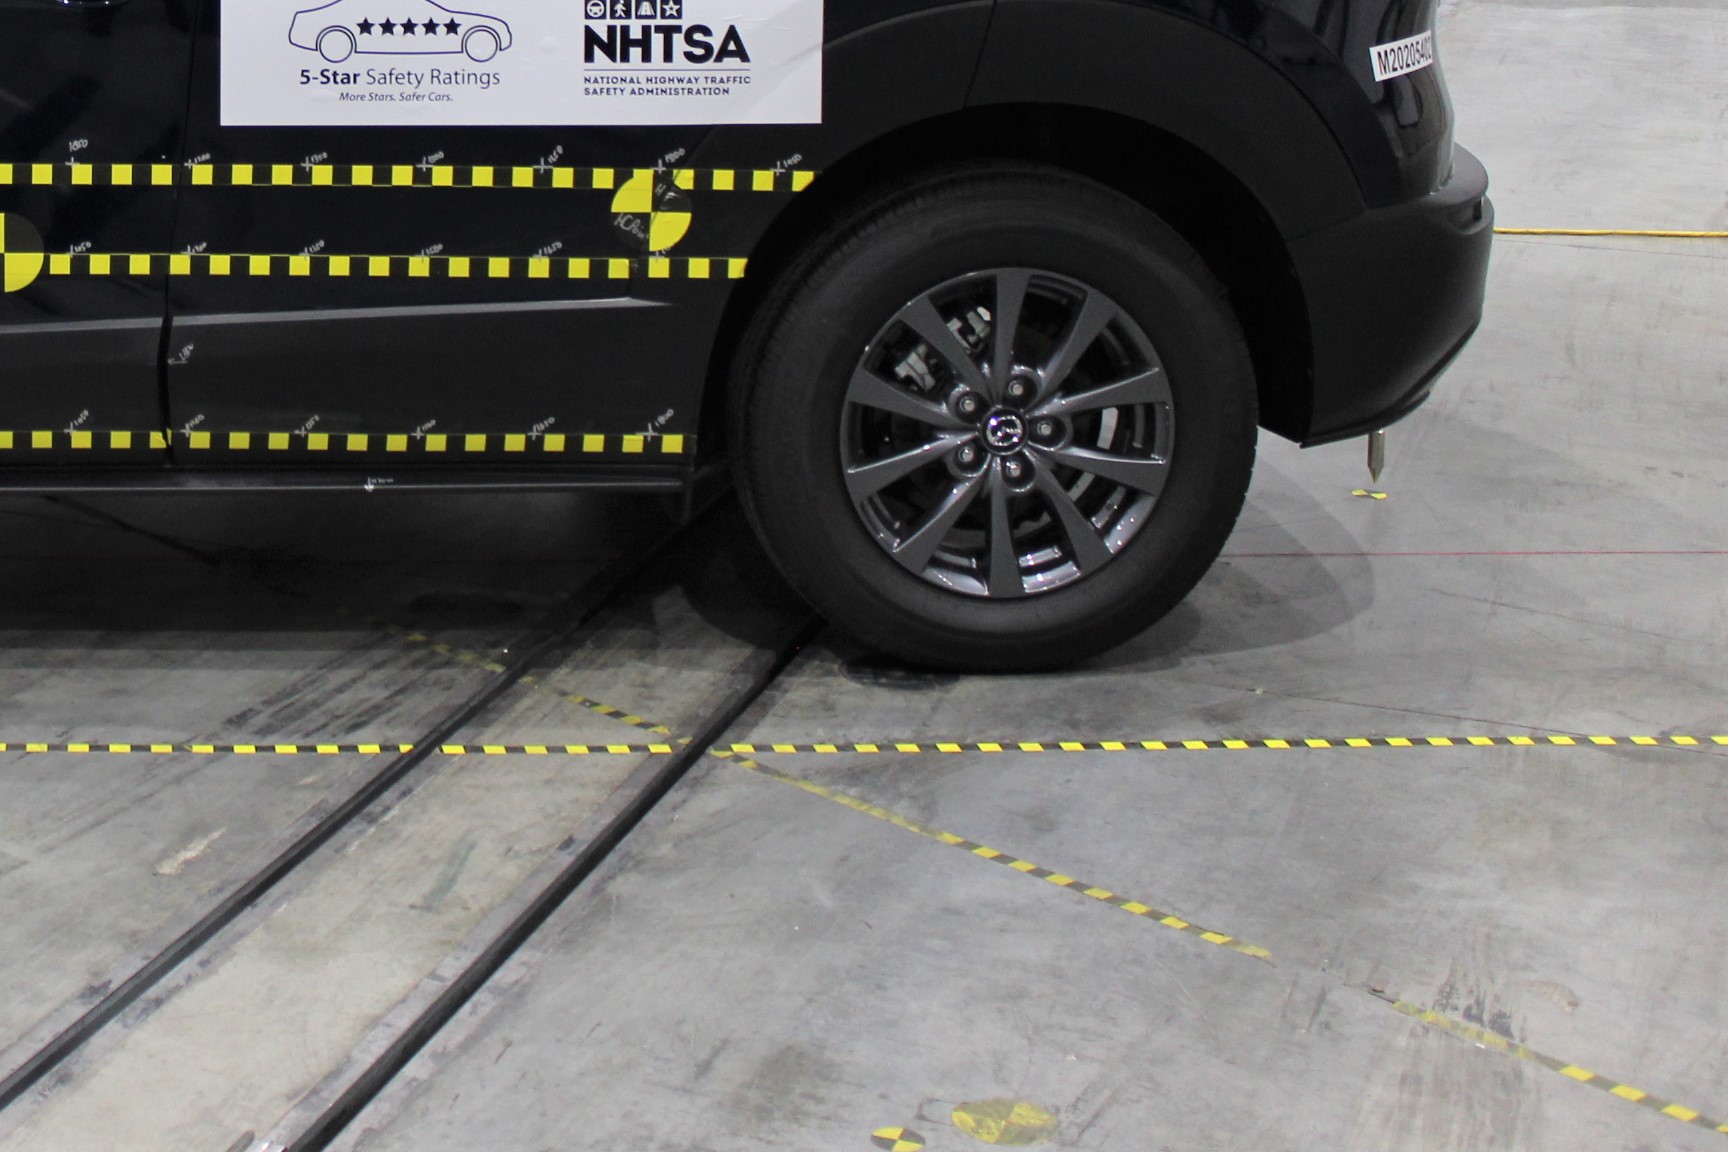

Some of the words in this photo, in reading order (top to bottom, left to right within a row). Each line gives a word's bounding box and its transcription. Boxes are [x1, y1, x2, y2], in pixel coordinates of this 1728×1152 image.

[584, 24, 751, 64] NHTSA
[299, 69, 361, 85] 5-Star
[366, 68, 424, 89] Safety
[430, 68, 500, 90] Ratings
[584, 76, 641, 85] NATIONAL
[646, 76, 700, 85] HIGHWAY
[704, 76, 751, 85] TRAFFIC
[584, 87, 626, 96] SAFETY
[629, 87, 730, 96] ADMINISTRATION
[339, 92, 366, 102] More
[368, 92, 397, 102] Stars.
[399, 92, 426, 102] Safer
[428, 92, 454, 102] Cars.
